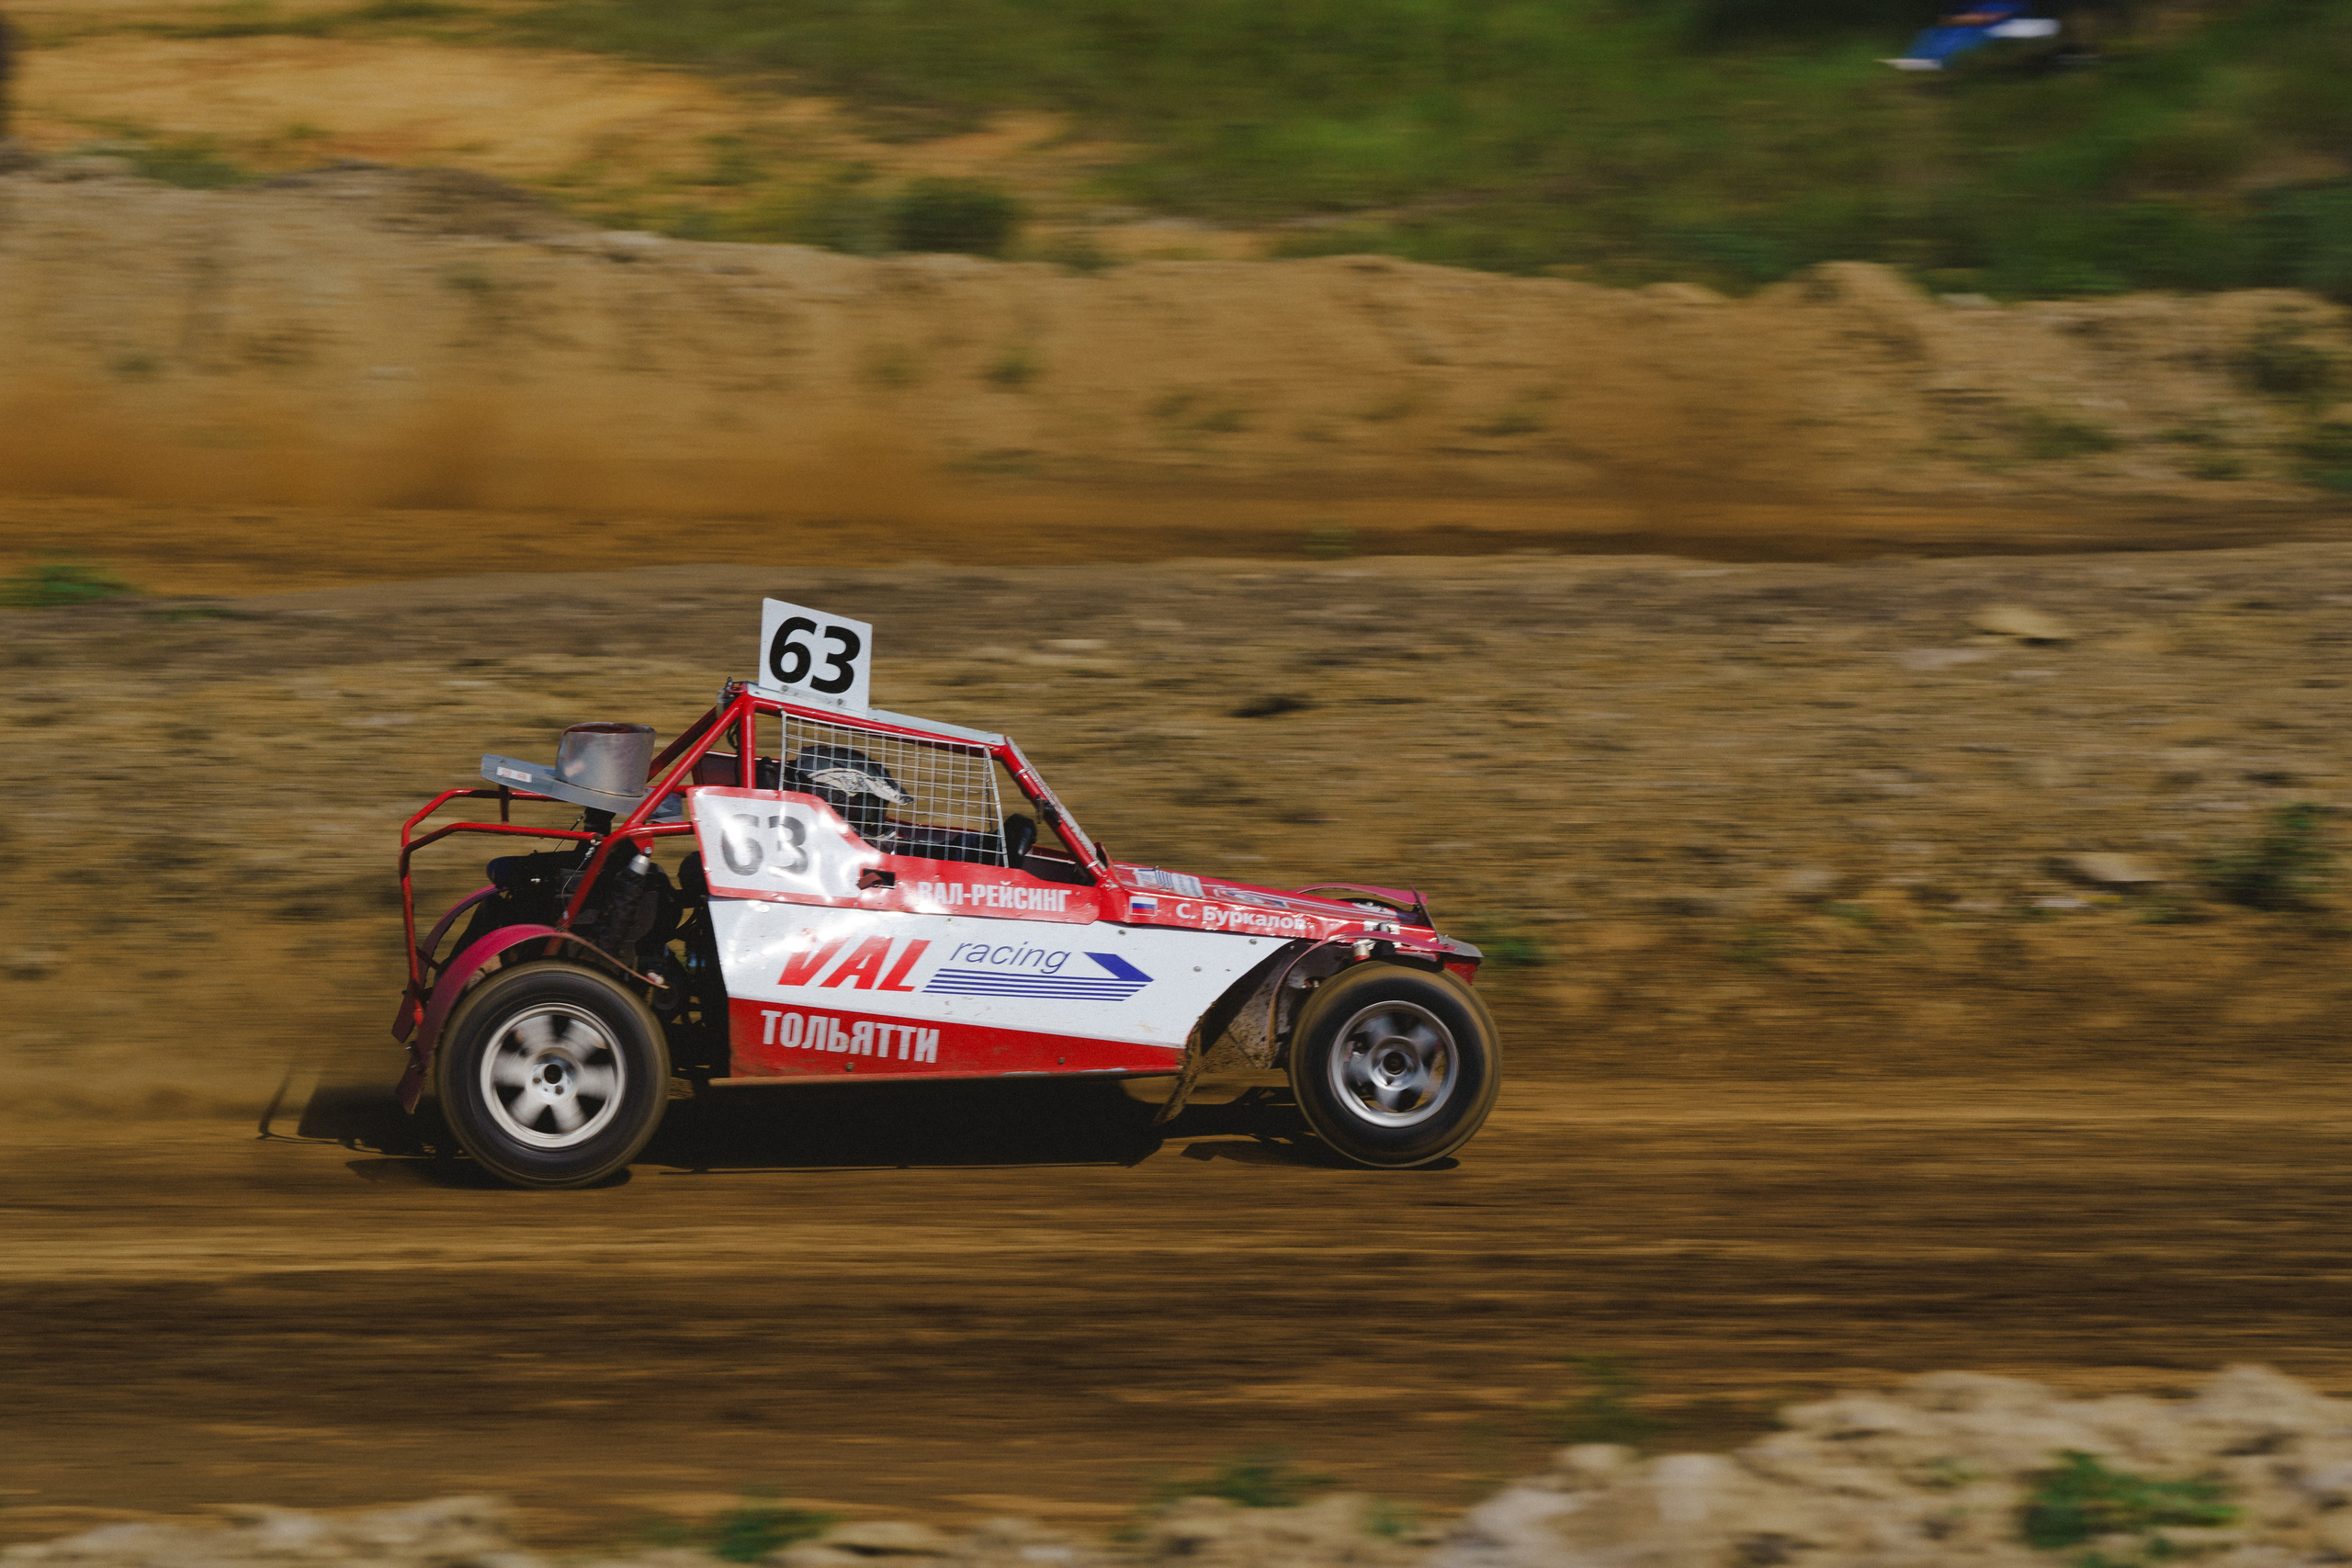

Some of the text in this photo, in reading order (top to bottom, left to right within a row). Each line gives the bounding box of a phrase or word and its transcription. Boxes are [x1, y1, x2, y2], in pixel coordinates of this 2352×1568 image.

[769, 616, 861, 694] 63
[721, 813, 808, 876] 63
[917, 880, 1073, 912] ВАЛ-РЕЙСИНГ
[1175, 903, 1308, 931] С. Буркалов
[776, 928, 1072, 992] VAL racing
[761, 1009, 940, 1064] ТОЛЬЯТТИ
